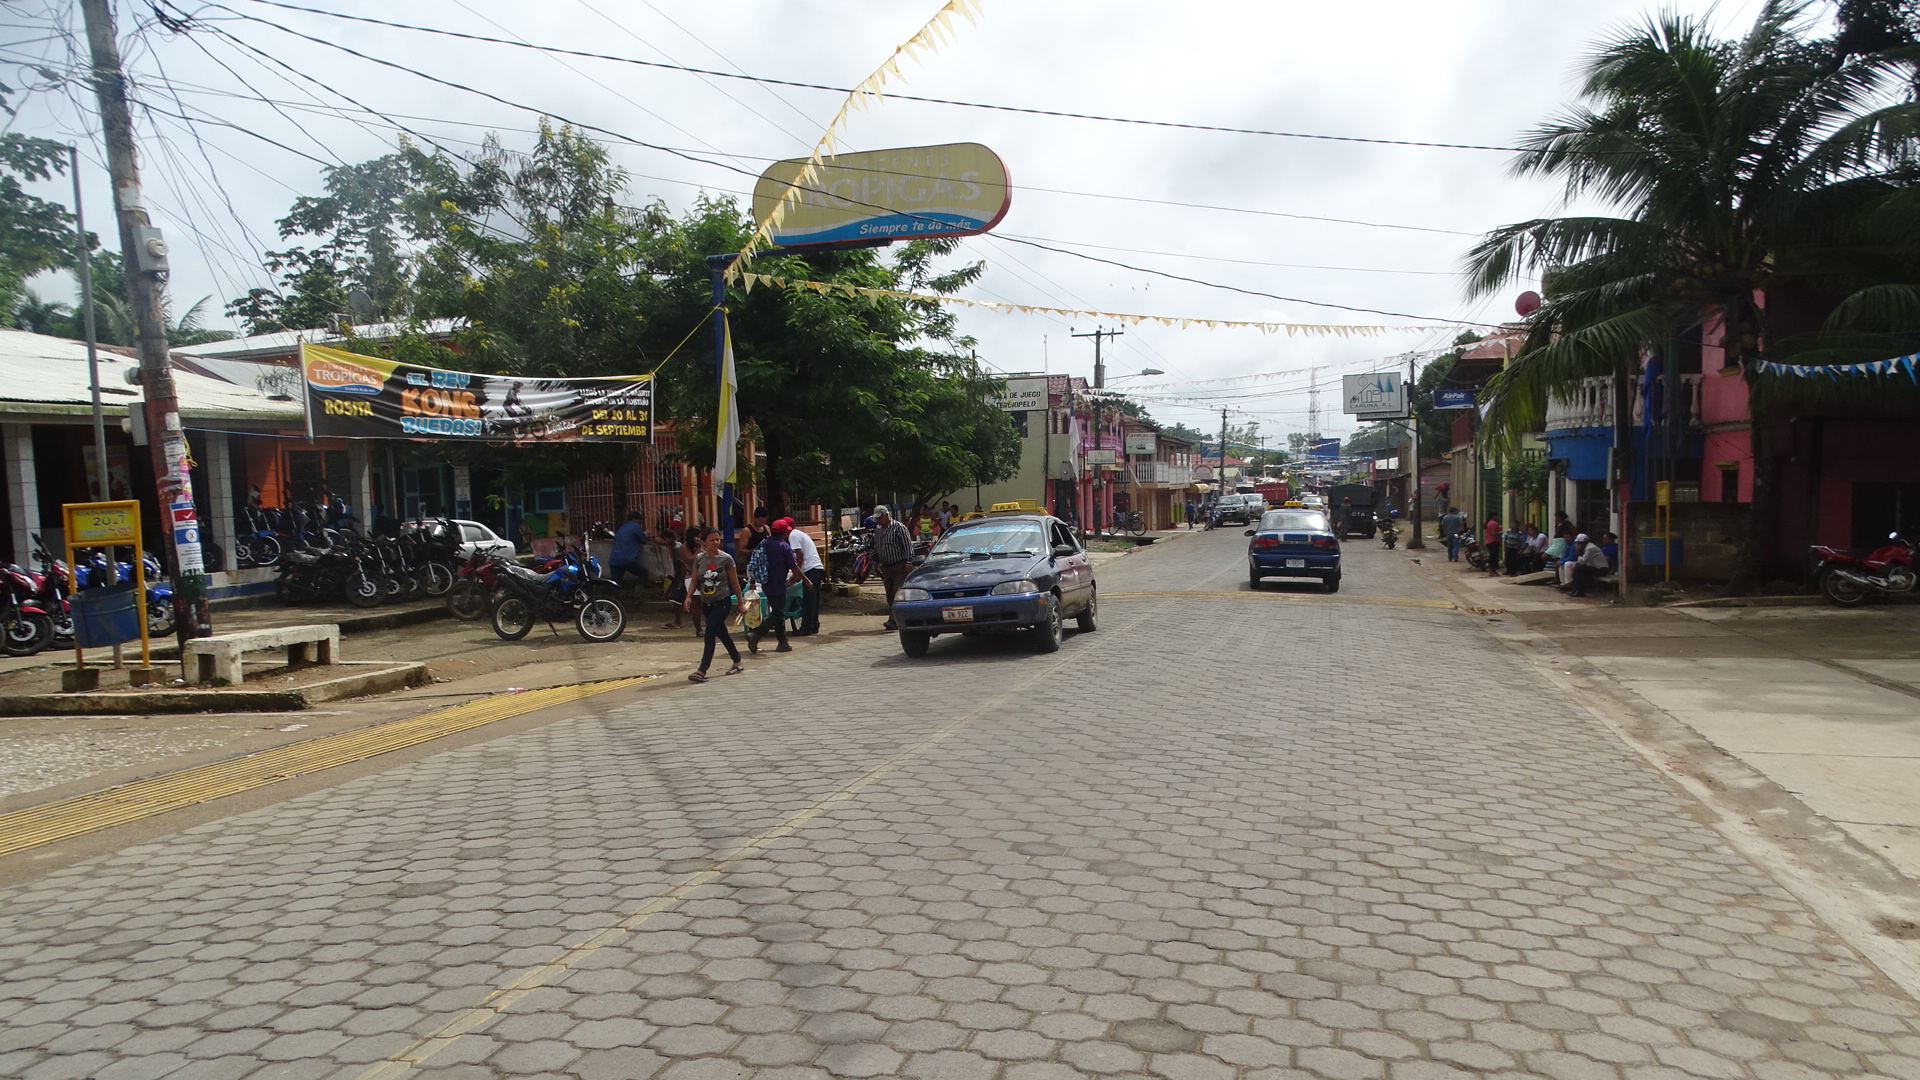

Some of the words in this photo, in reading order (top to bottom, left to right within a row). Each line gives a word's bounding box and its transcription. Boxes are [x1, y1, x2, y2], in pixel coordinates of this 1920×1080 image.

[812, 153, 949, 176] LMACENES
[778, 171, 982, 211] TROPIGAS
[859, 222, 908, 236] Siempre
[912, 220, 925, 232] te
[946, 218, 972, 230] más
[313, 369, 378, 385] TROPIGAS
[430, 370, 471, 389] REY
[401, 388, 480, 418] KONG
[1020, 390, 1040, 398] JUEGO
[1442, 392, 1465, 400] AirPak
[324, 399, 374, 417] ROSITA
[592, 409, 609, 420] DEL
[611, 410, 624, 420] 20
[626, 410, 637, 421] AL
[400, 416, 483, 436] RUEDAS!
[581, 424, 595, 436] DE
[93, 514, 125, 526] 2017
